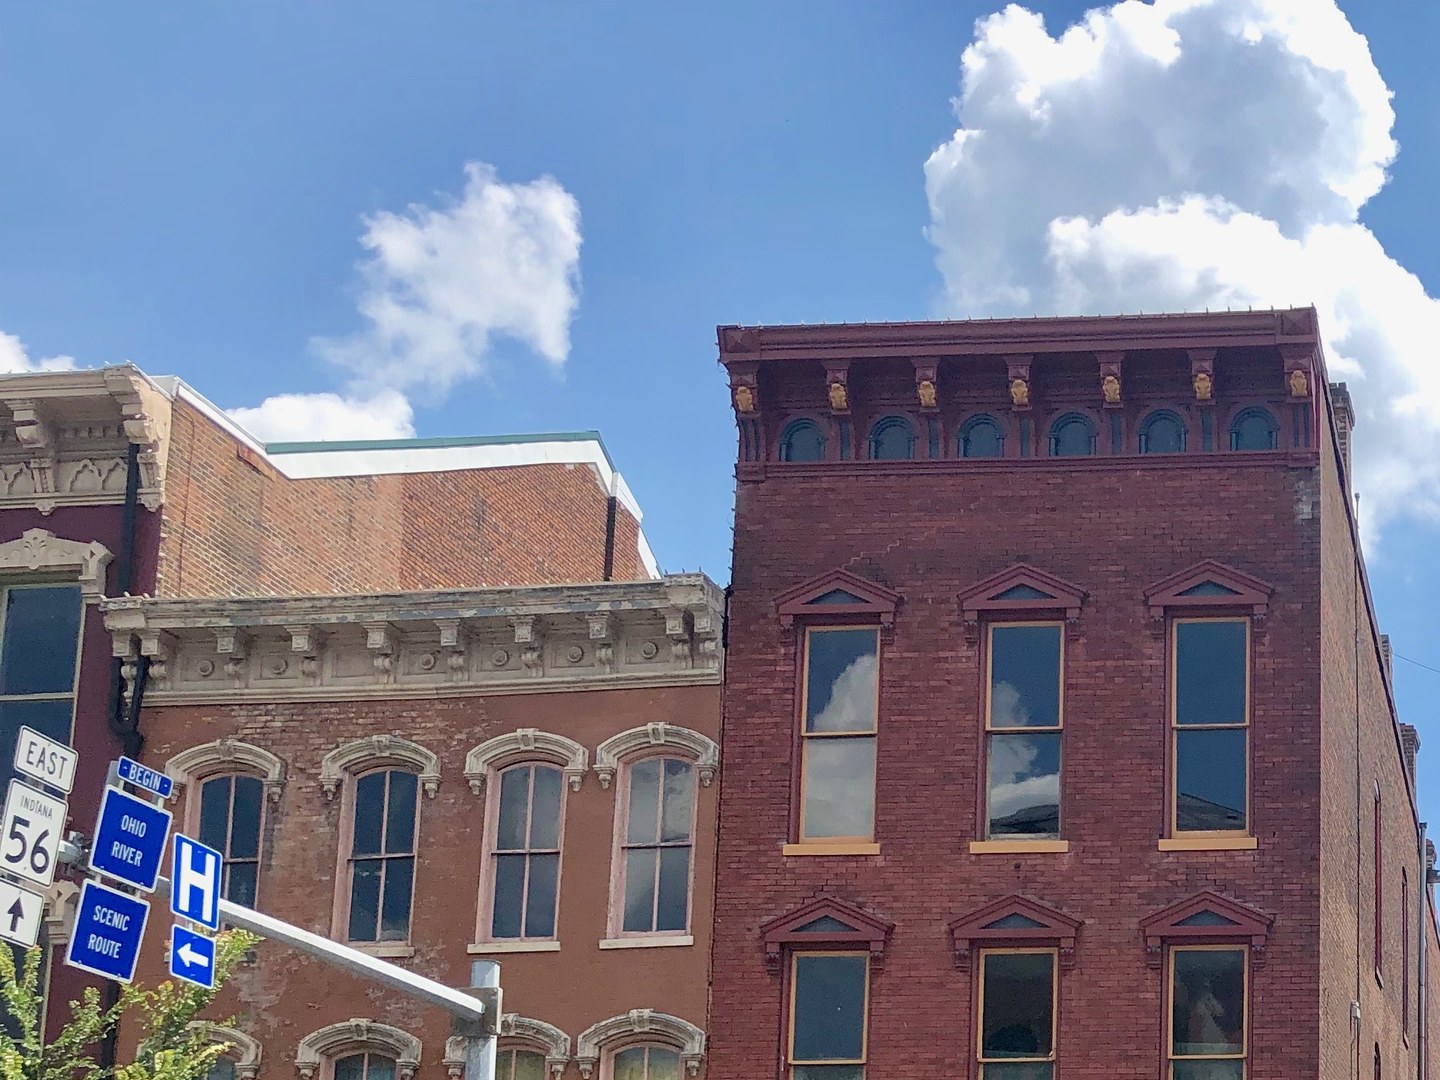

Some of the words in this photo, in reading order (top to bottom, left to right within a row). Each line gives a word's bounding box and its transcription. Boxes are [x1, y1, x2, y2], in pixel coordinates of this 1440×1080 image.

[25, 740, 69, 780] EAST
[127, 763, 162, 792] BEGIN
[20, 795, 53, 820] INDIANA
[120, 814, 148, 839] OHIO
[4, 814, 51, 875] 56
[110, 840, 144, 867] RIVER
[178, 841, 217, 923] H
[92, 904, 131, 932] SCENIC
[87, 933, 123, 959] ROUTE
